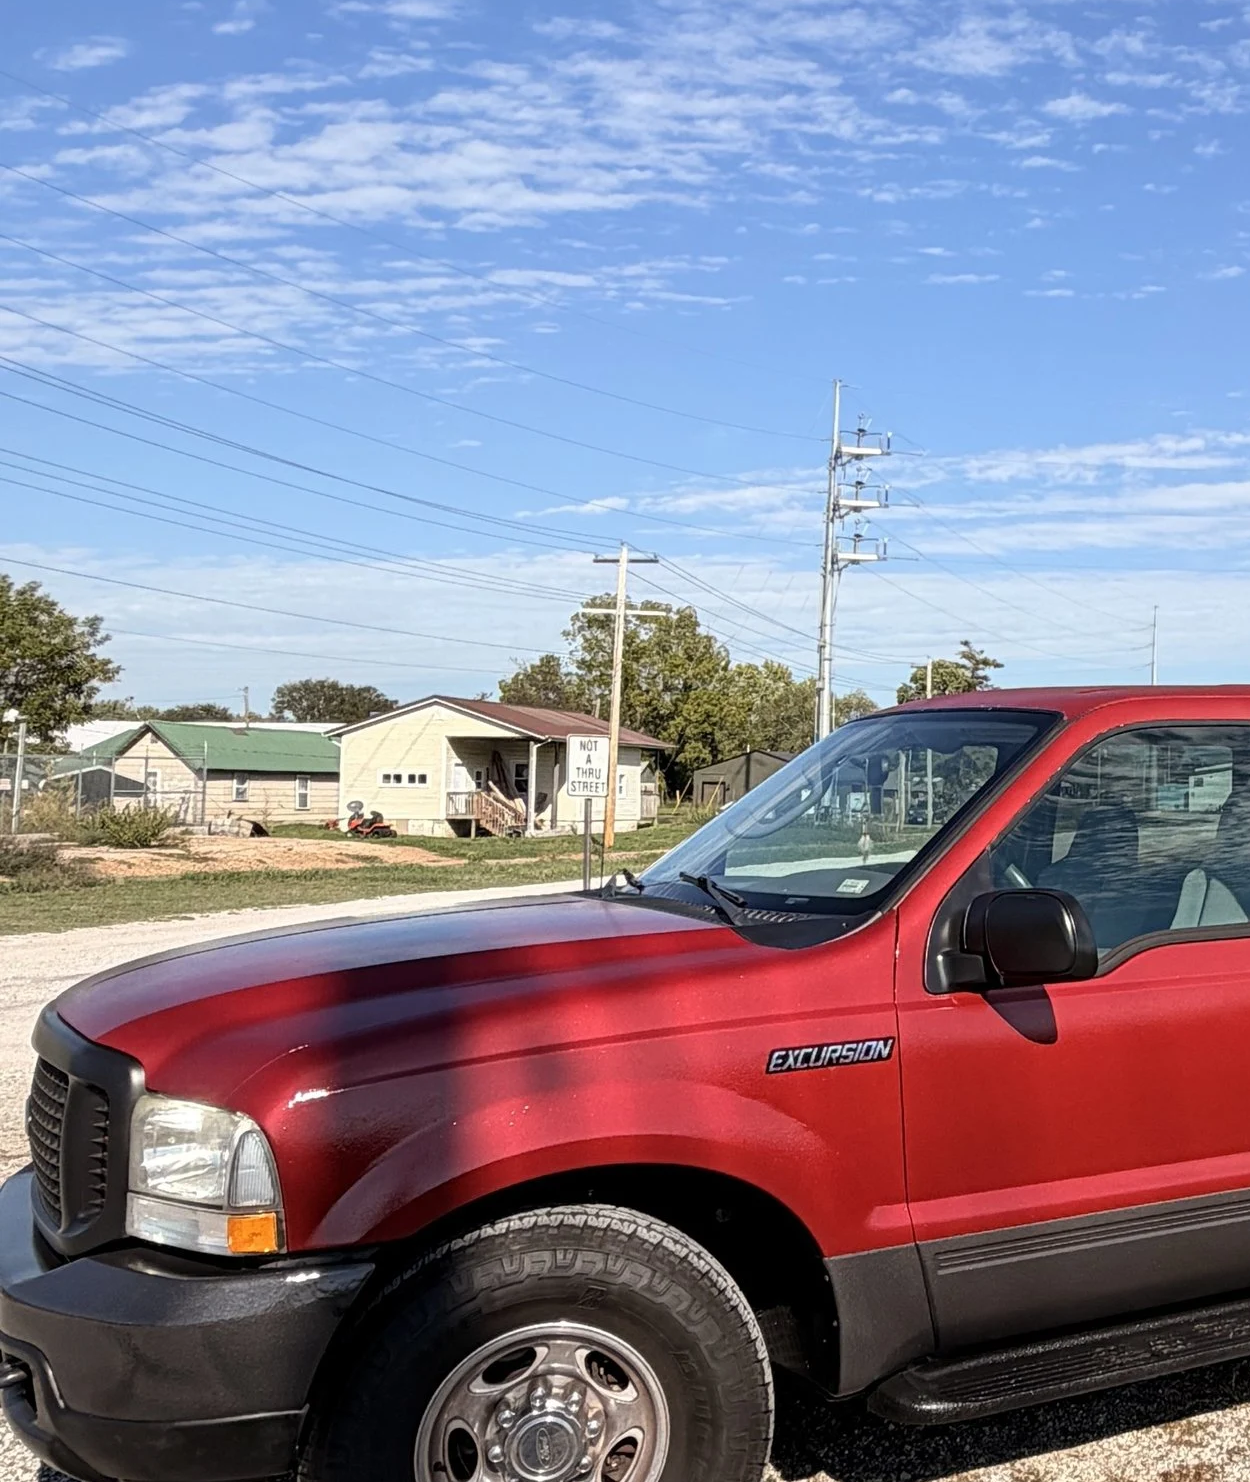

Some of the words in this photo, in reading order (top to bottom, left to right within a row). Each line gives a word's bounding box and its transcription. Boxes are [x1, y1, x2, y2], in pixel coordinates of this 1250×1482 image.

[580, 739, 598, 752] NOT
[586, 753, 592, 765] A
[576, 767, 601, 779] THRU
[571, 780, 606, 793] STREET
[768, 1038, 893, 1073] EXCURSION
